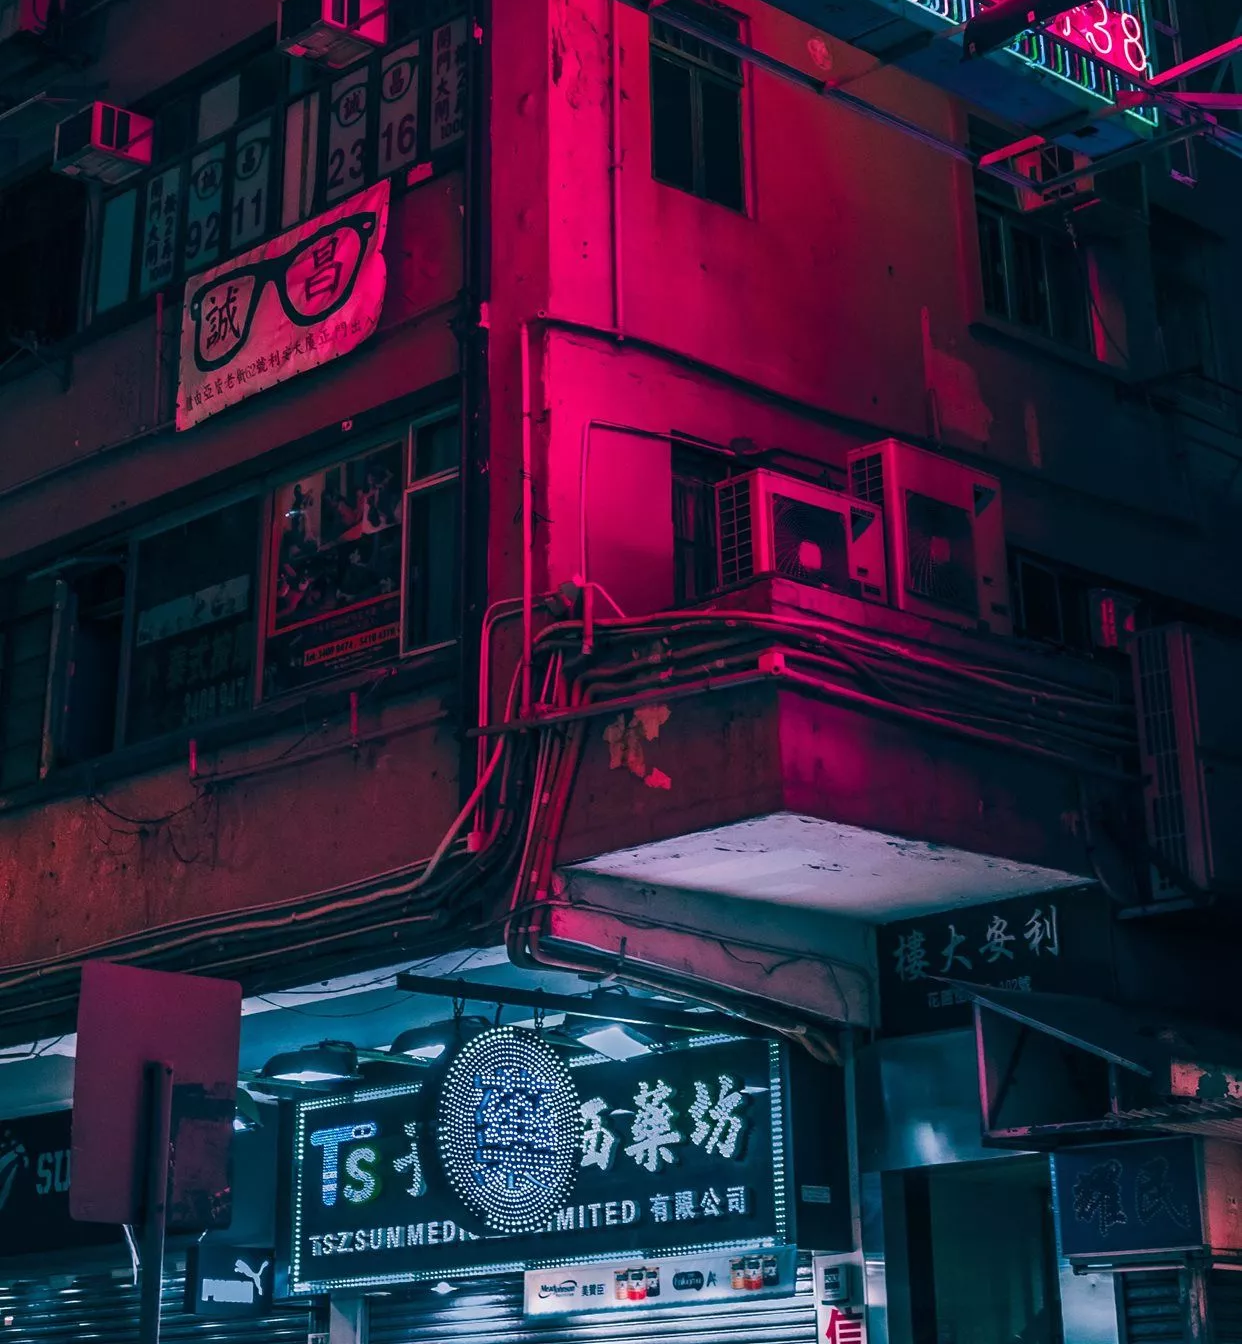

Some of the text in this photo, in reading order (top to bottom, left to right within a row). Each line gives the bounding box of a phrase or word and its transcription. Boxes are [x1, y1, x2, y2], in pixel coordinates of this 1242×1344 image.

[381, 113, 415, 162] 16
[650, 1184, 746, 1224] 有限公司
